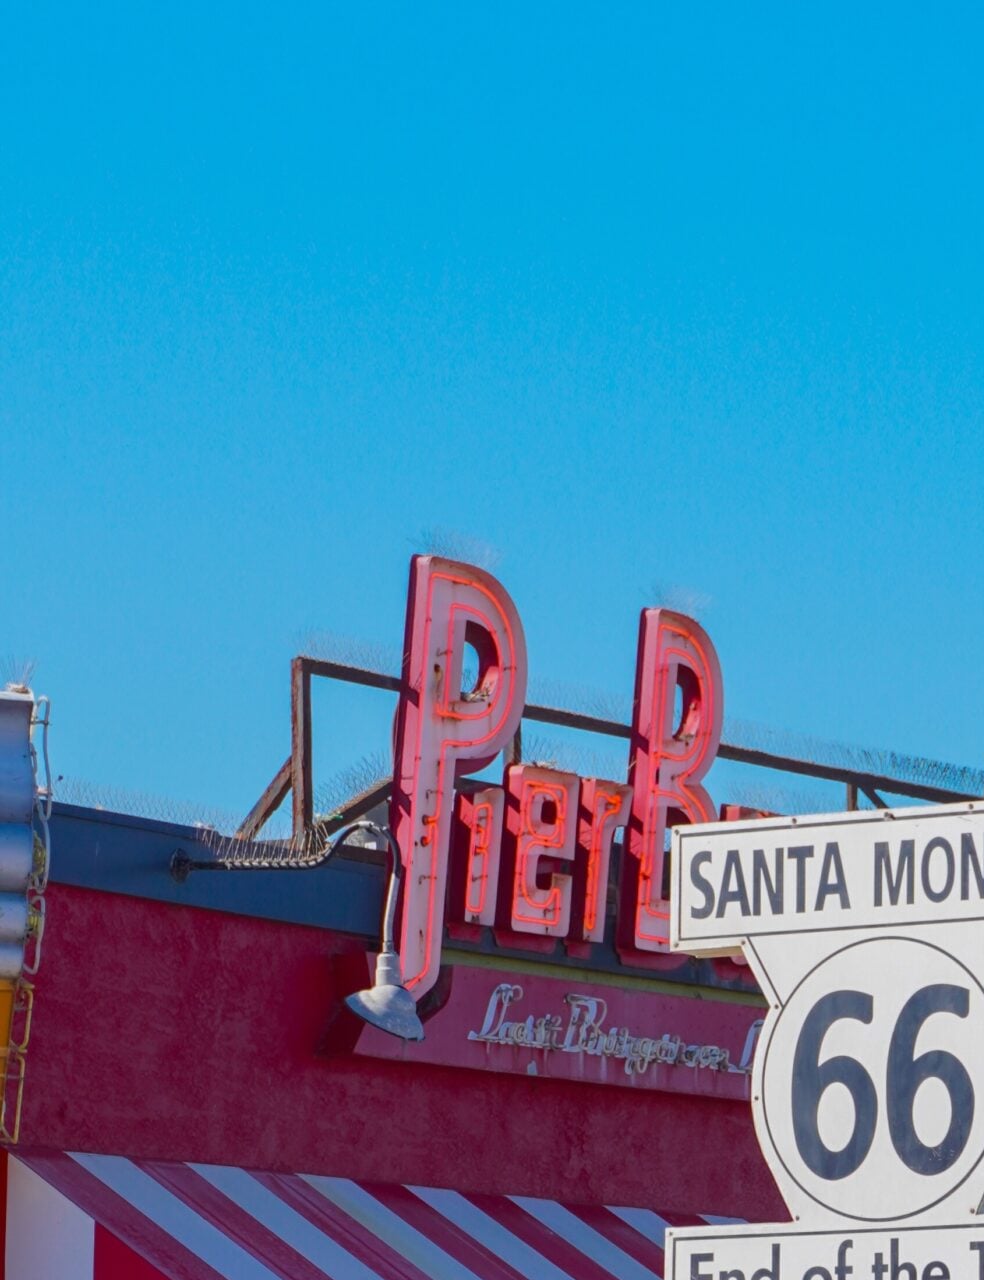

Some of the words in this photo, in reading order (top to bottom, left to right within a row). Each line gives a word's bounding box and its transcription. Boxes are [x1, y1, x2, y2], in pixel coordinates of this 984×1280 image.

[390, 555, 634, 998] Pier
[688, 841, 852, 921] SANTA
[790, 982, 976, 1182] 66
